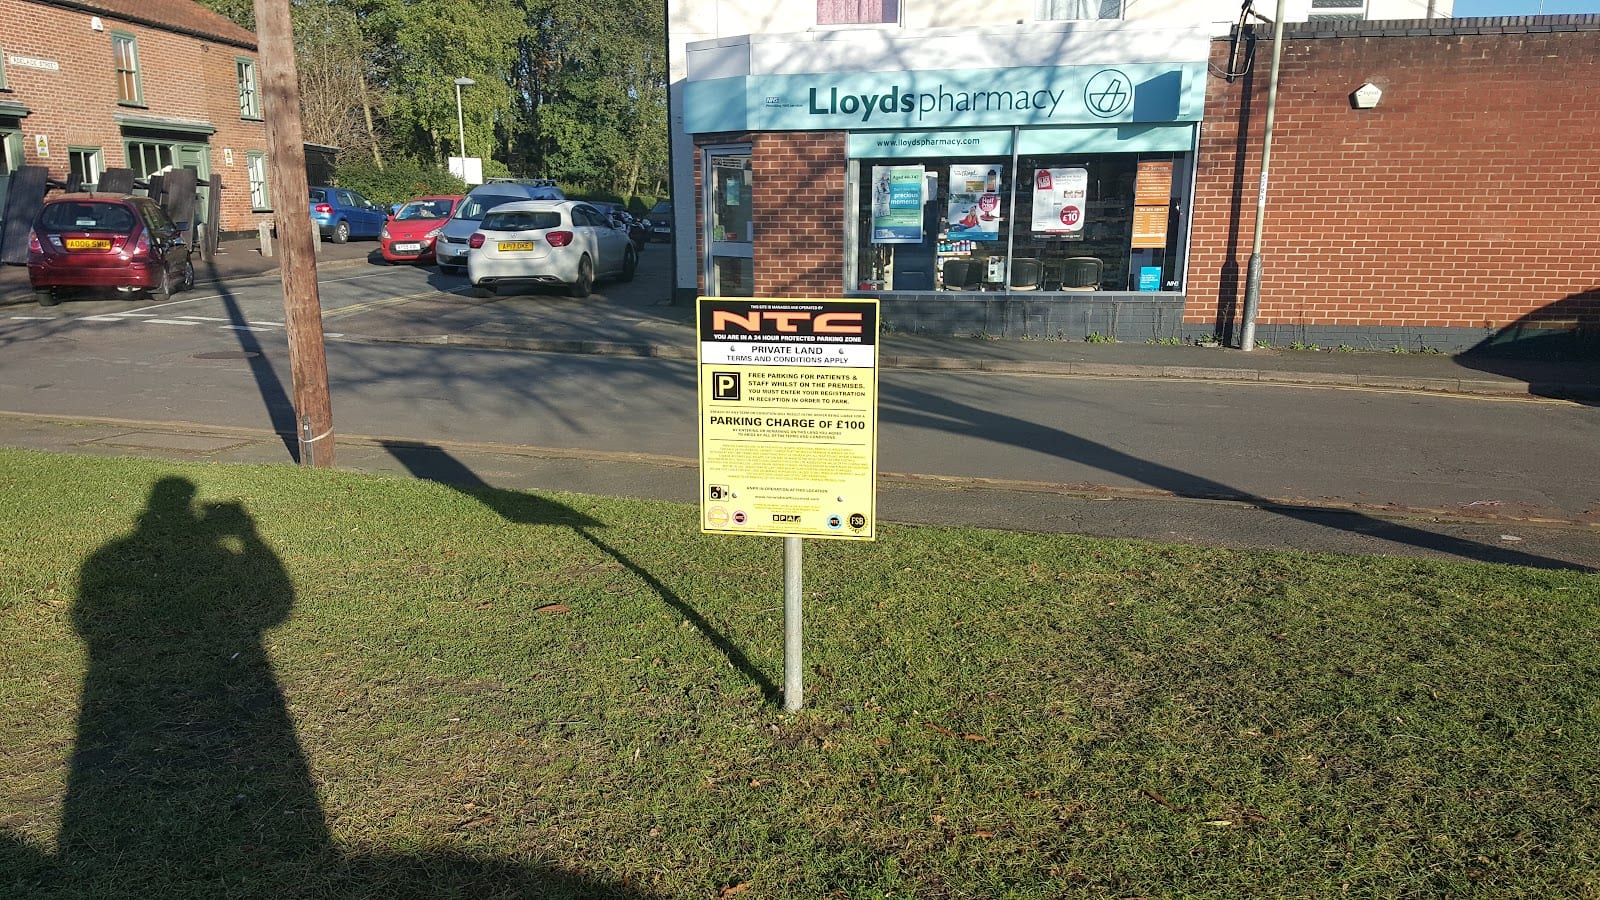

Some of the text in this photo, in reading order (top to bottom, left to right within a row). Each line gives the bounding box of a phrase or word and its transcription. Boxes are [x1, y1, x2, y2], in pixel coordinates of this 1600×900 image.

[809, 84, 1065, 122] Lloydspharmacy
[876, 137, 980, 147] www.lloydspharmacy.com
[894, 191, 918, 199] precious
[1062, 213, 1077, 221] £10
[713, 310, 863, 334] NTC
[751, 346, 823, 355] PRIVATE LAND
[718, 375, 735, 396] P
[710, 416, 865, 430] PARKING CHARGE OF £100
[851, 517, 864, 525] FSB
